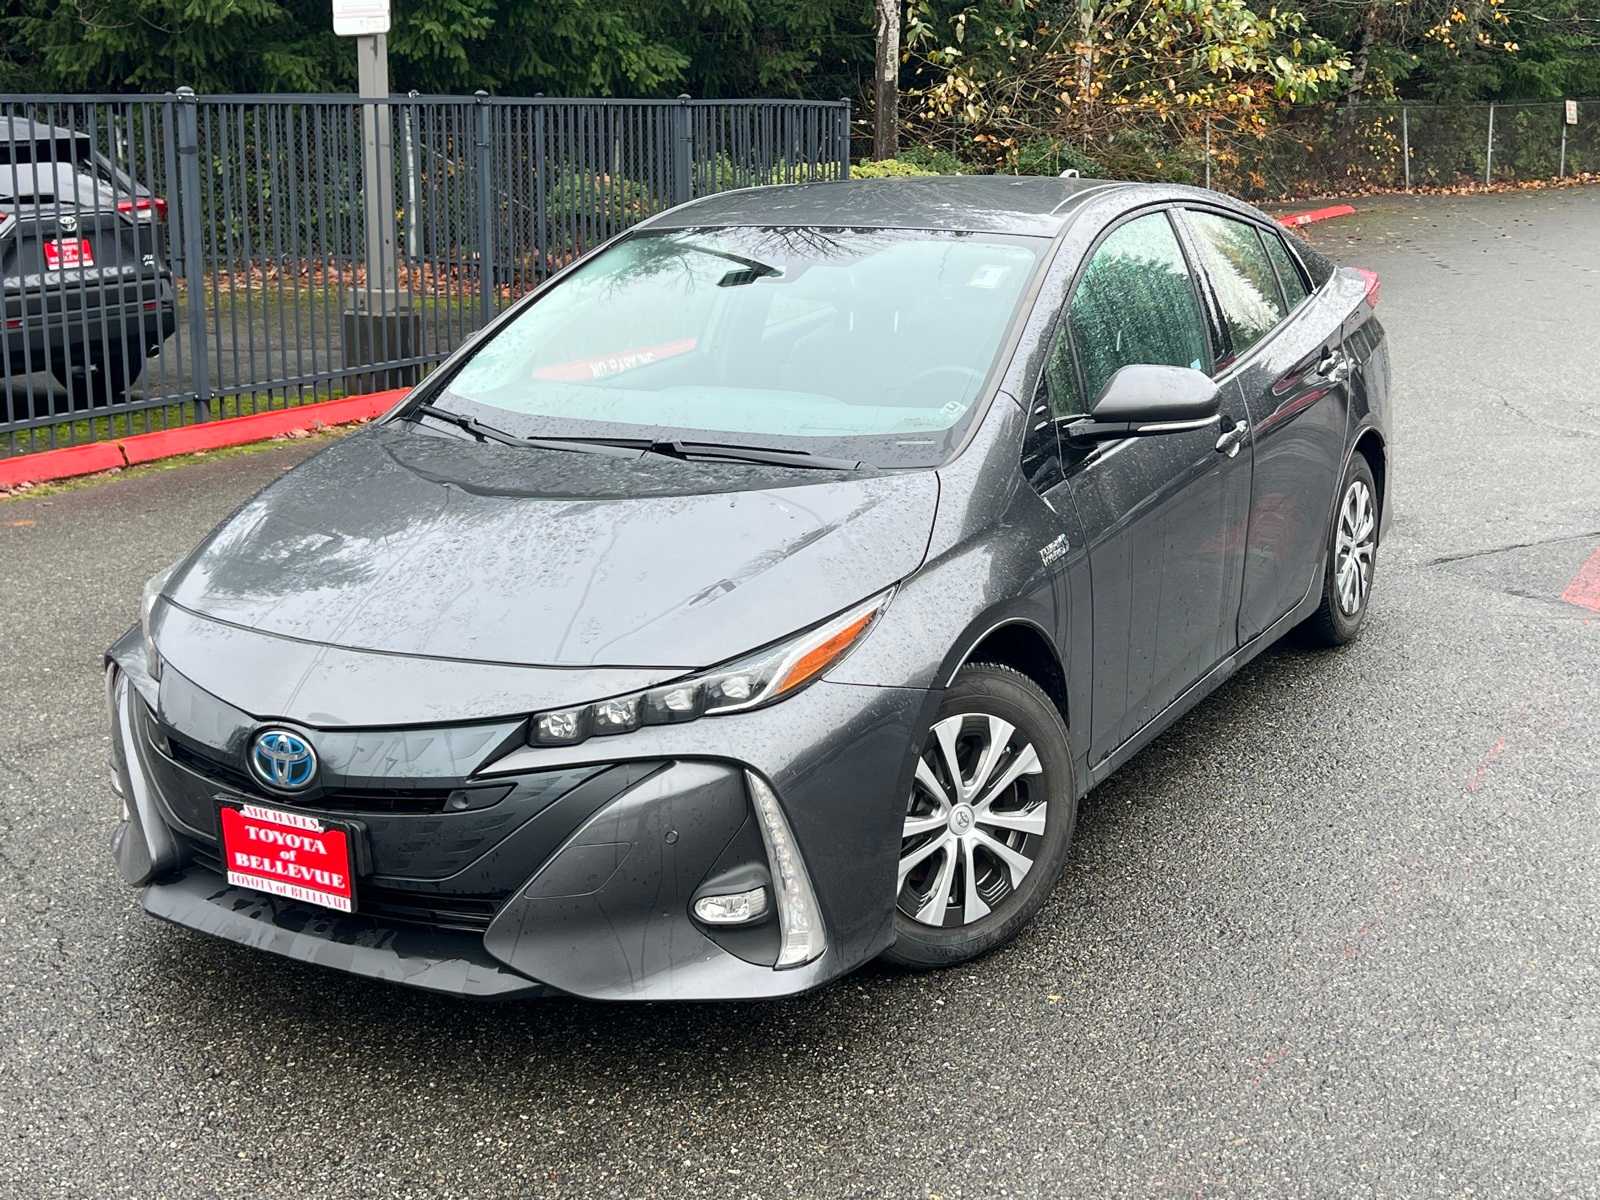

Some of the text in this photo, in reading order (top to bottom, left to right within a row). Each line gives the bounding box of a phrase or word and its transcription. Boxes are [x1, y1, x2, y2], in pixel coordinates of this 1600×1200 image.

[244, 825, 328, 855] TOYOTA
[234, 852, 345, 889] BELLEVUE
[279, 850, 297, 862] of
